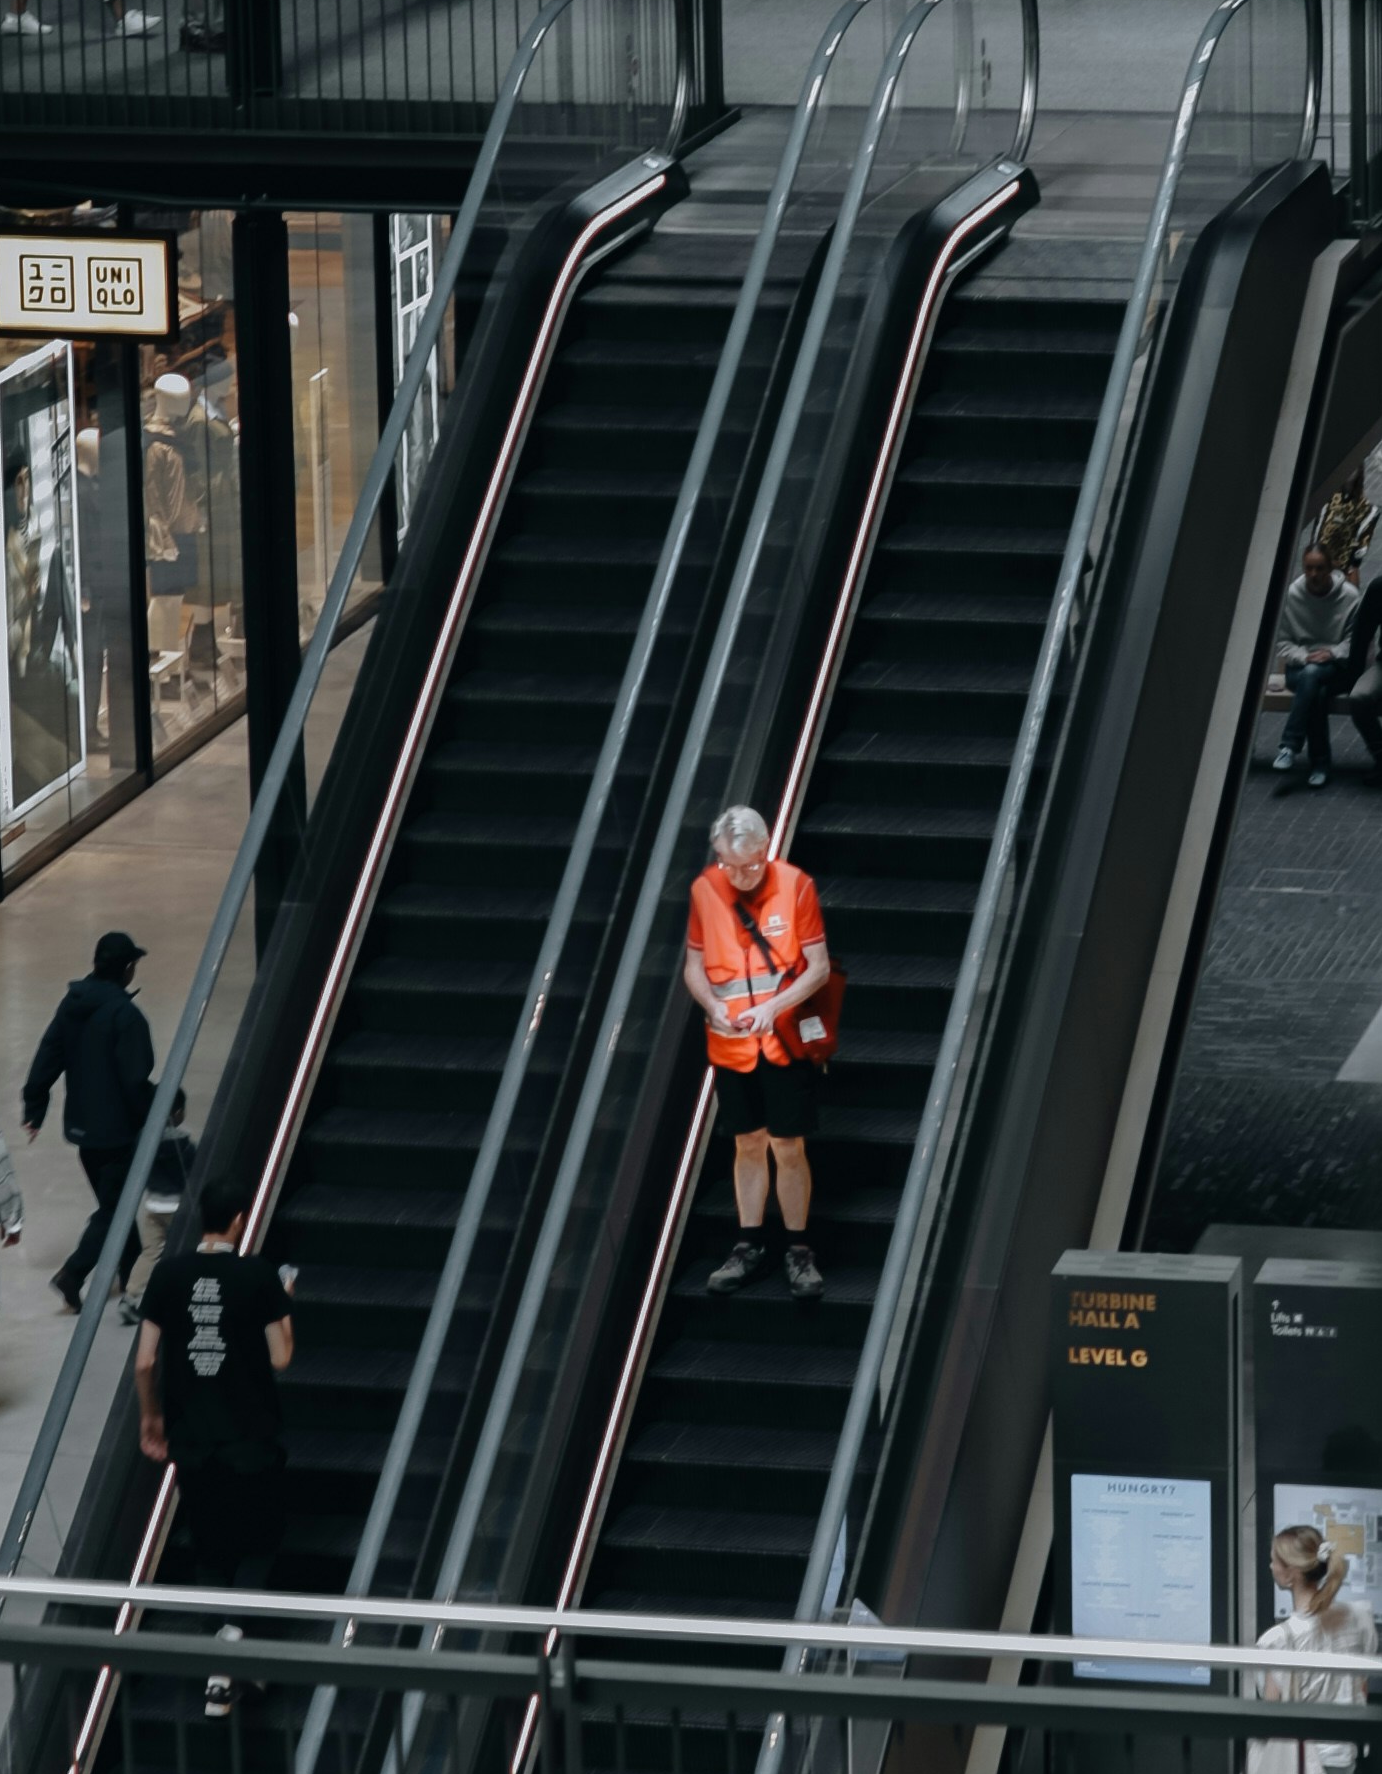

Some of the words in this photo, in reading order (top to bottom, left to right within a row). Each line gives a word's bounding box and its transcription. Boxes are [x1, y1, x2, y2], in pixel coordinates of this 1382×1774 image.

[96, 266, 131, 284] UNI
[96, 288, 135, 308] QLO
[1070, 1291, 1156, 1311] TURBINE
[1068, 1310, 1121, 1328] HALL
[1124, 1312, 1140, 1329] A
[1270, 1312, 1290, 1324] Lifts
[1270, 1324, 1302, 1337] Toilets
[1068, 1347, 1127, 1366] LEVEL
[1130, 1349, 1148, 1367] G
[1107, 1483, 1177, 1495] HUNGRY?
